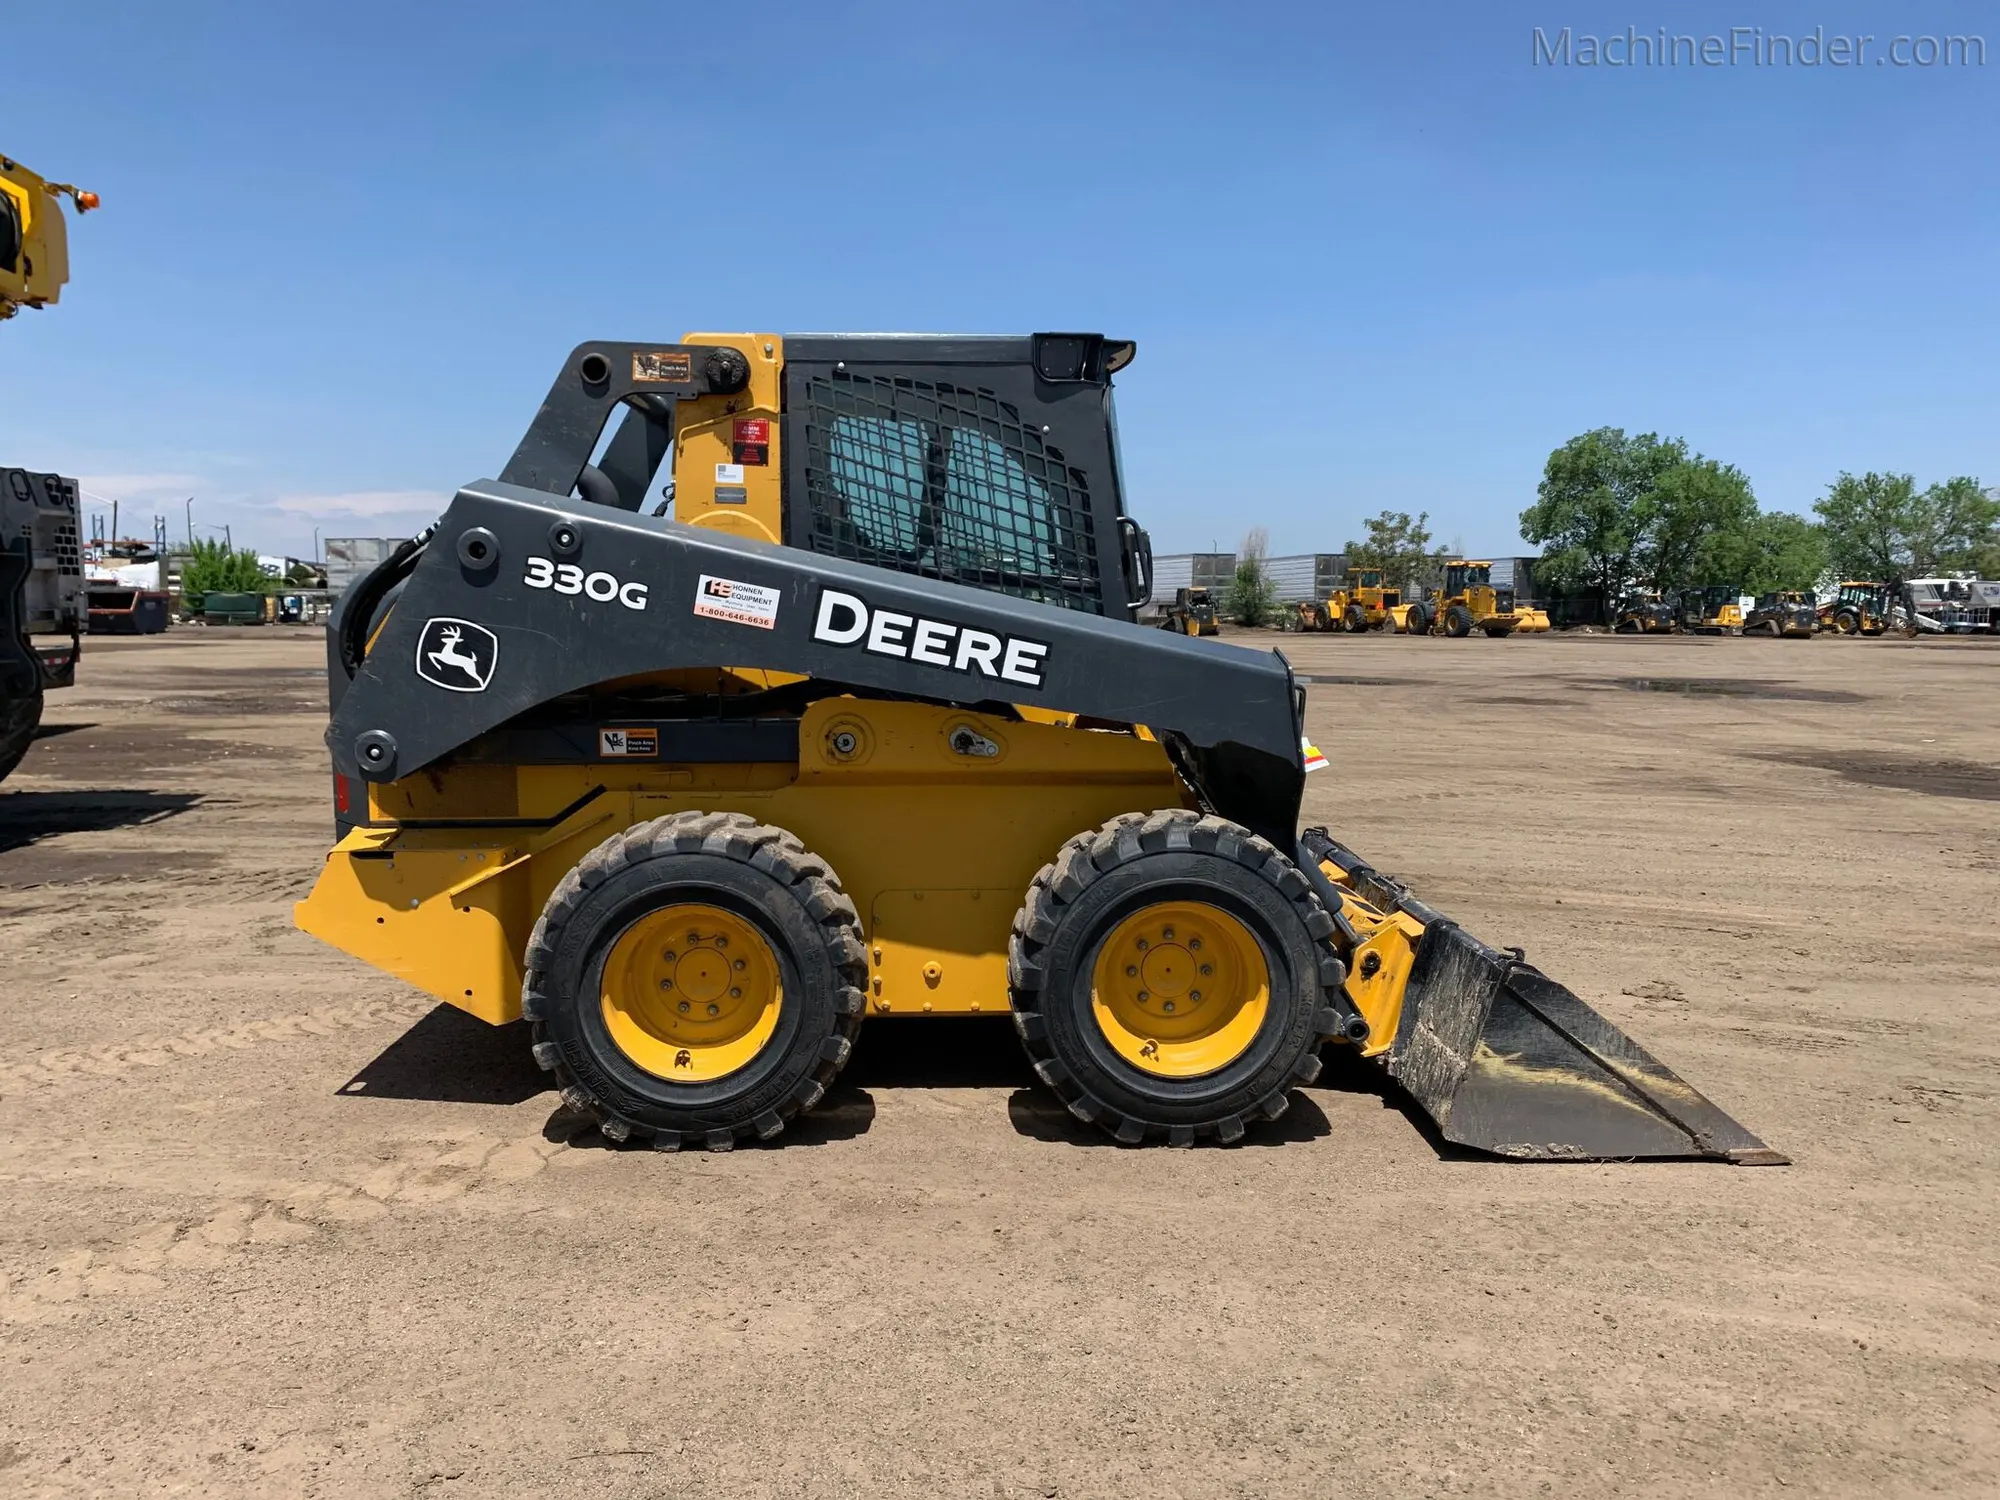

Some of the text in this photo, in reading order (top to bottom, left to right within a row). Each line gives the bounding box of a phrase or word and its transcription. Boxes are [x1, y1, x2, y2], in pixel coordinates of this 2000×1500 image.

[524, 556, 649, 610] 330G
[732, 584, 763, 596] HONNEN
[731, 592, 773, 606] EQUIPMENT
[699, 606, 770, 626] 1-800-646-6636
[814, 589, 1048, 686] DEERE
